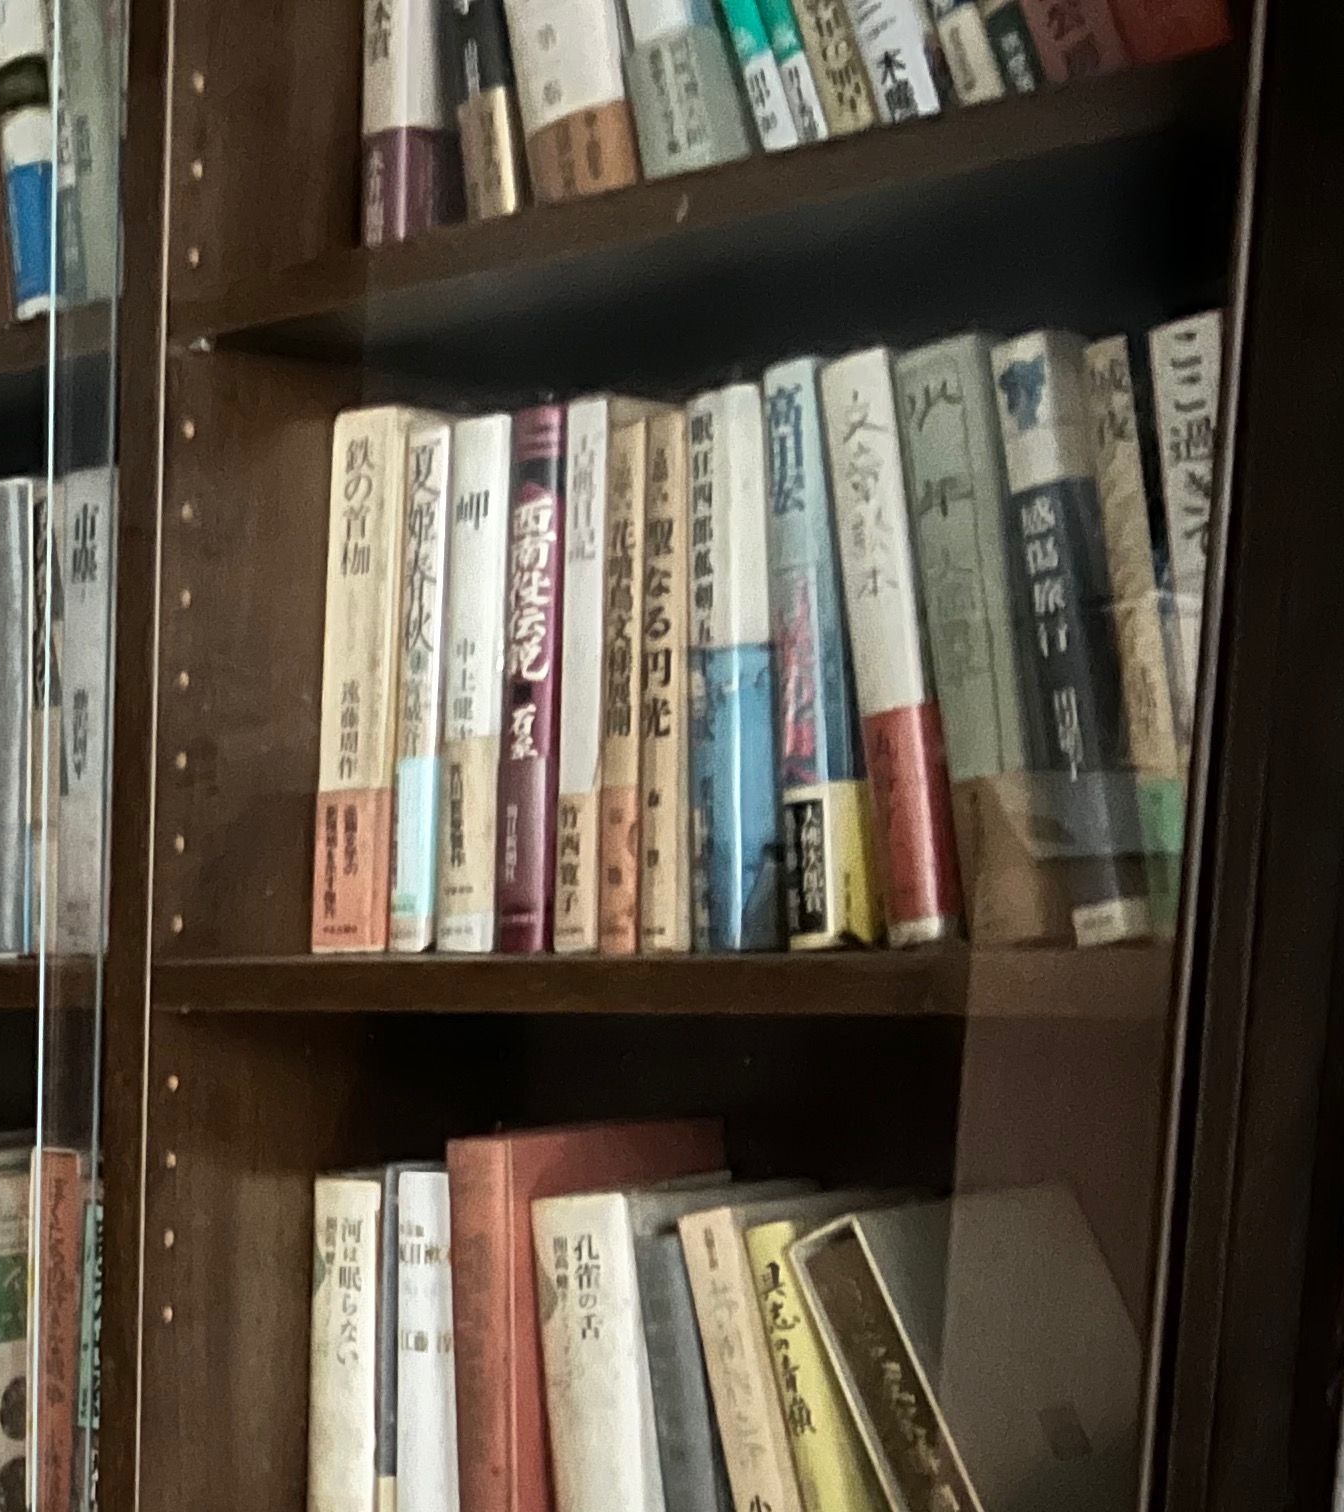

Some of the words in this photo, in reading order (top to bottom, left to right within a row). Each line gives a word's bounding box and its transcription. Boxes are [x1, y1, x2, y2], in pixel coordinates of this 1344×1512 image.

[339, 434, 375, 577] 鉄の首枷
[456, 489, 490, 531] 岬
[336, 1215, 364, 1366] 河は眠らない
[574, 1233, 603, 1341] 孔雀の舌
